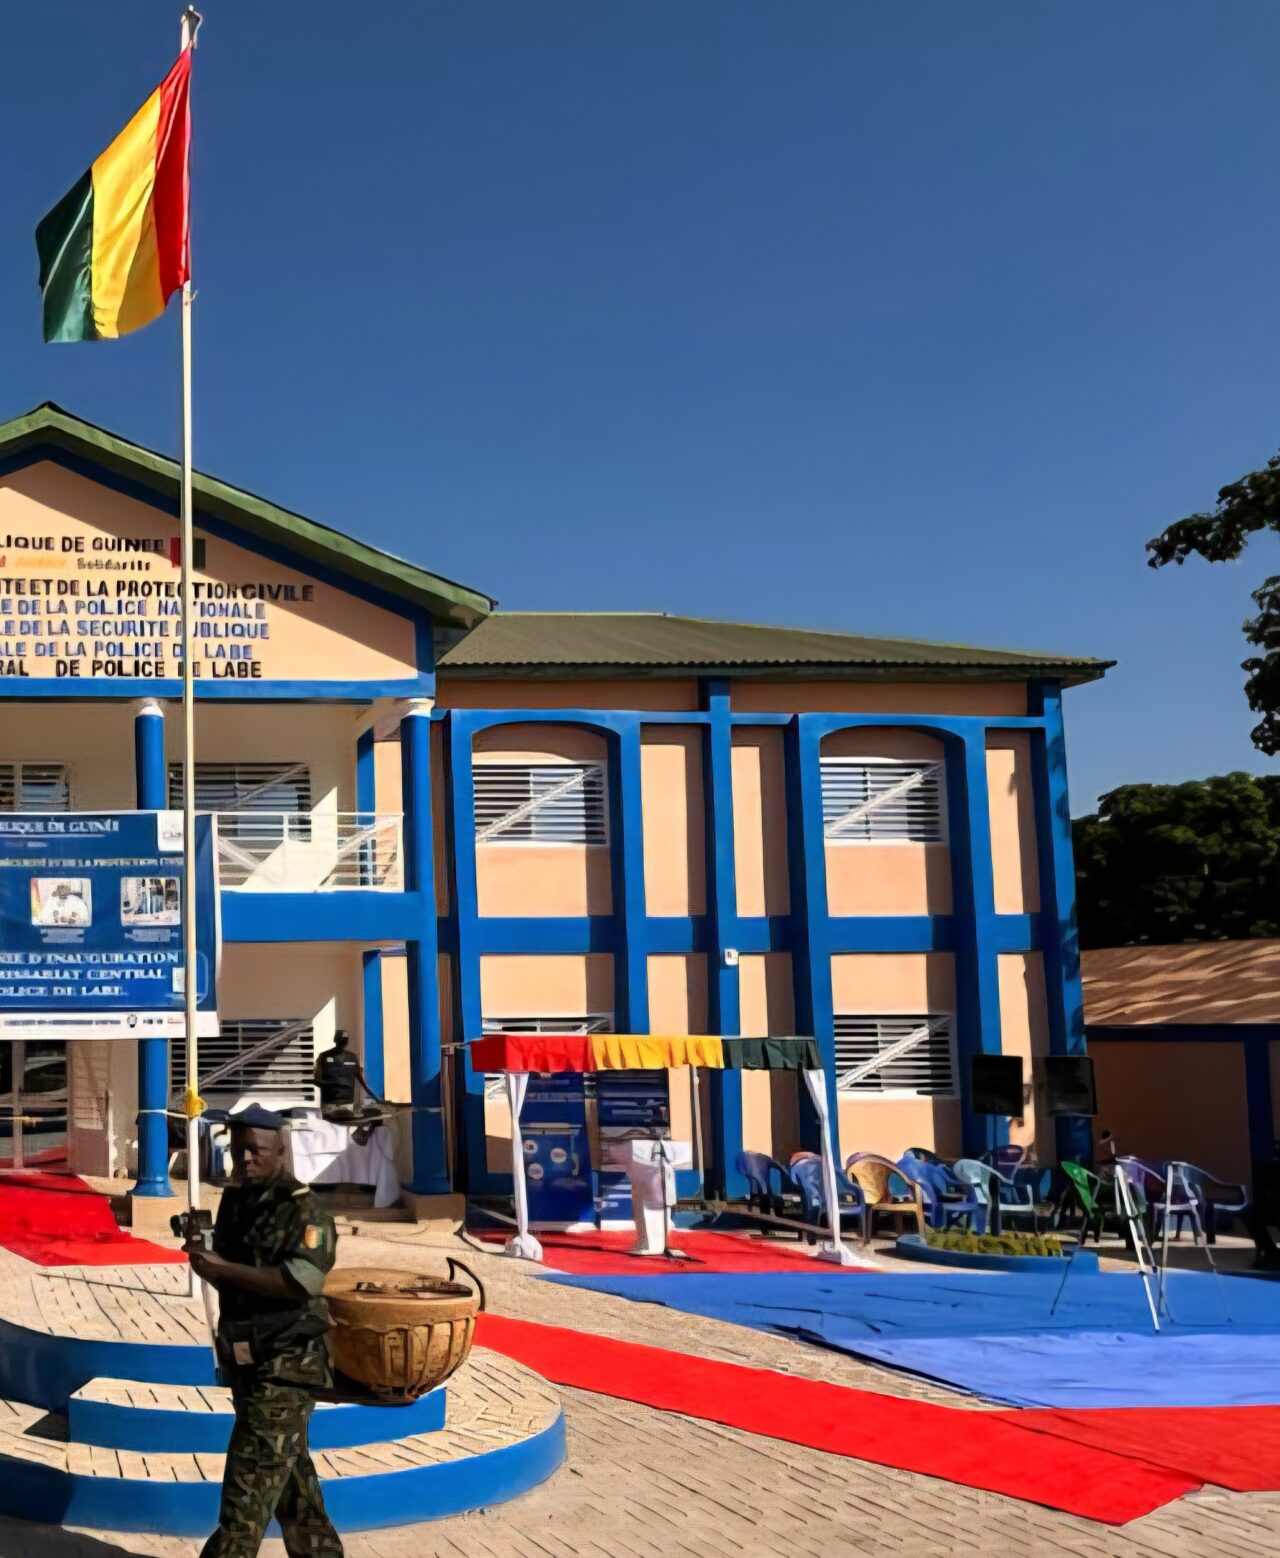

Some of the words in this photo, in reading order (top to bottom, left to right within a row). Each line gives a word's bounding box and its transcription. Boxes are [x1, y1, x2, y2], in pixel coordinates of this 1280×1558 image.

[61, 536, 85, 552] DE
[57, 579, 80, 596] DE
[86, 580, 109, 597] LA
[17, 598, 42, 615] DE
[46, 599, 68, 615] LA
[75, 599, 147, 617] POLICE
[19, 619, 43, 636] DE
[47, 620, 71, 637] LA
[34, 641, 58, 657] DE
[65, 641, 87, 657] LA
[95, 642, 163, 658] POLICE
[205, 643, 253, 660] LABE
[56, 659, 80, 677] DE
[92, 660, 165, 678] POLICE
[212, 661, 262, 678] LABE
